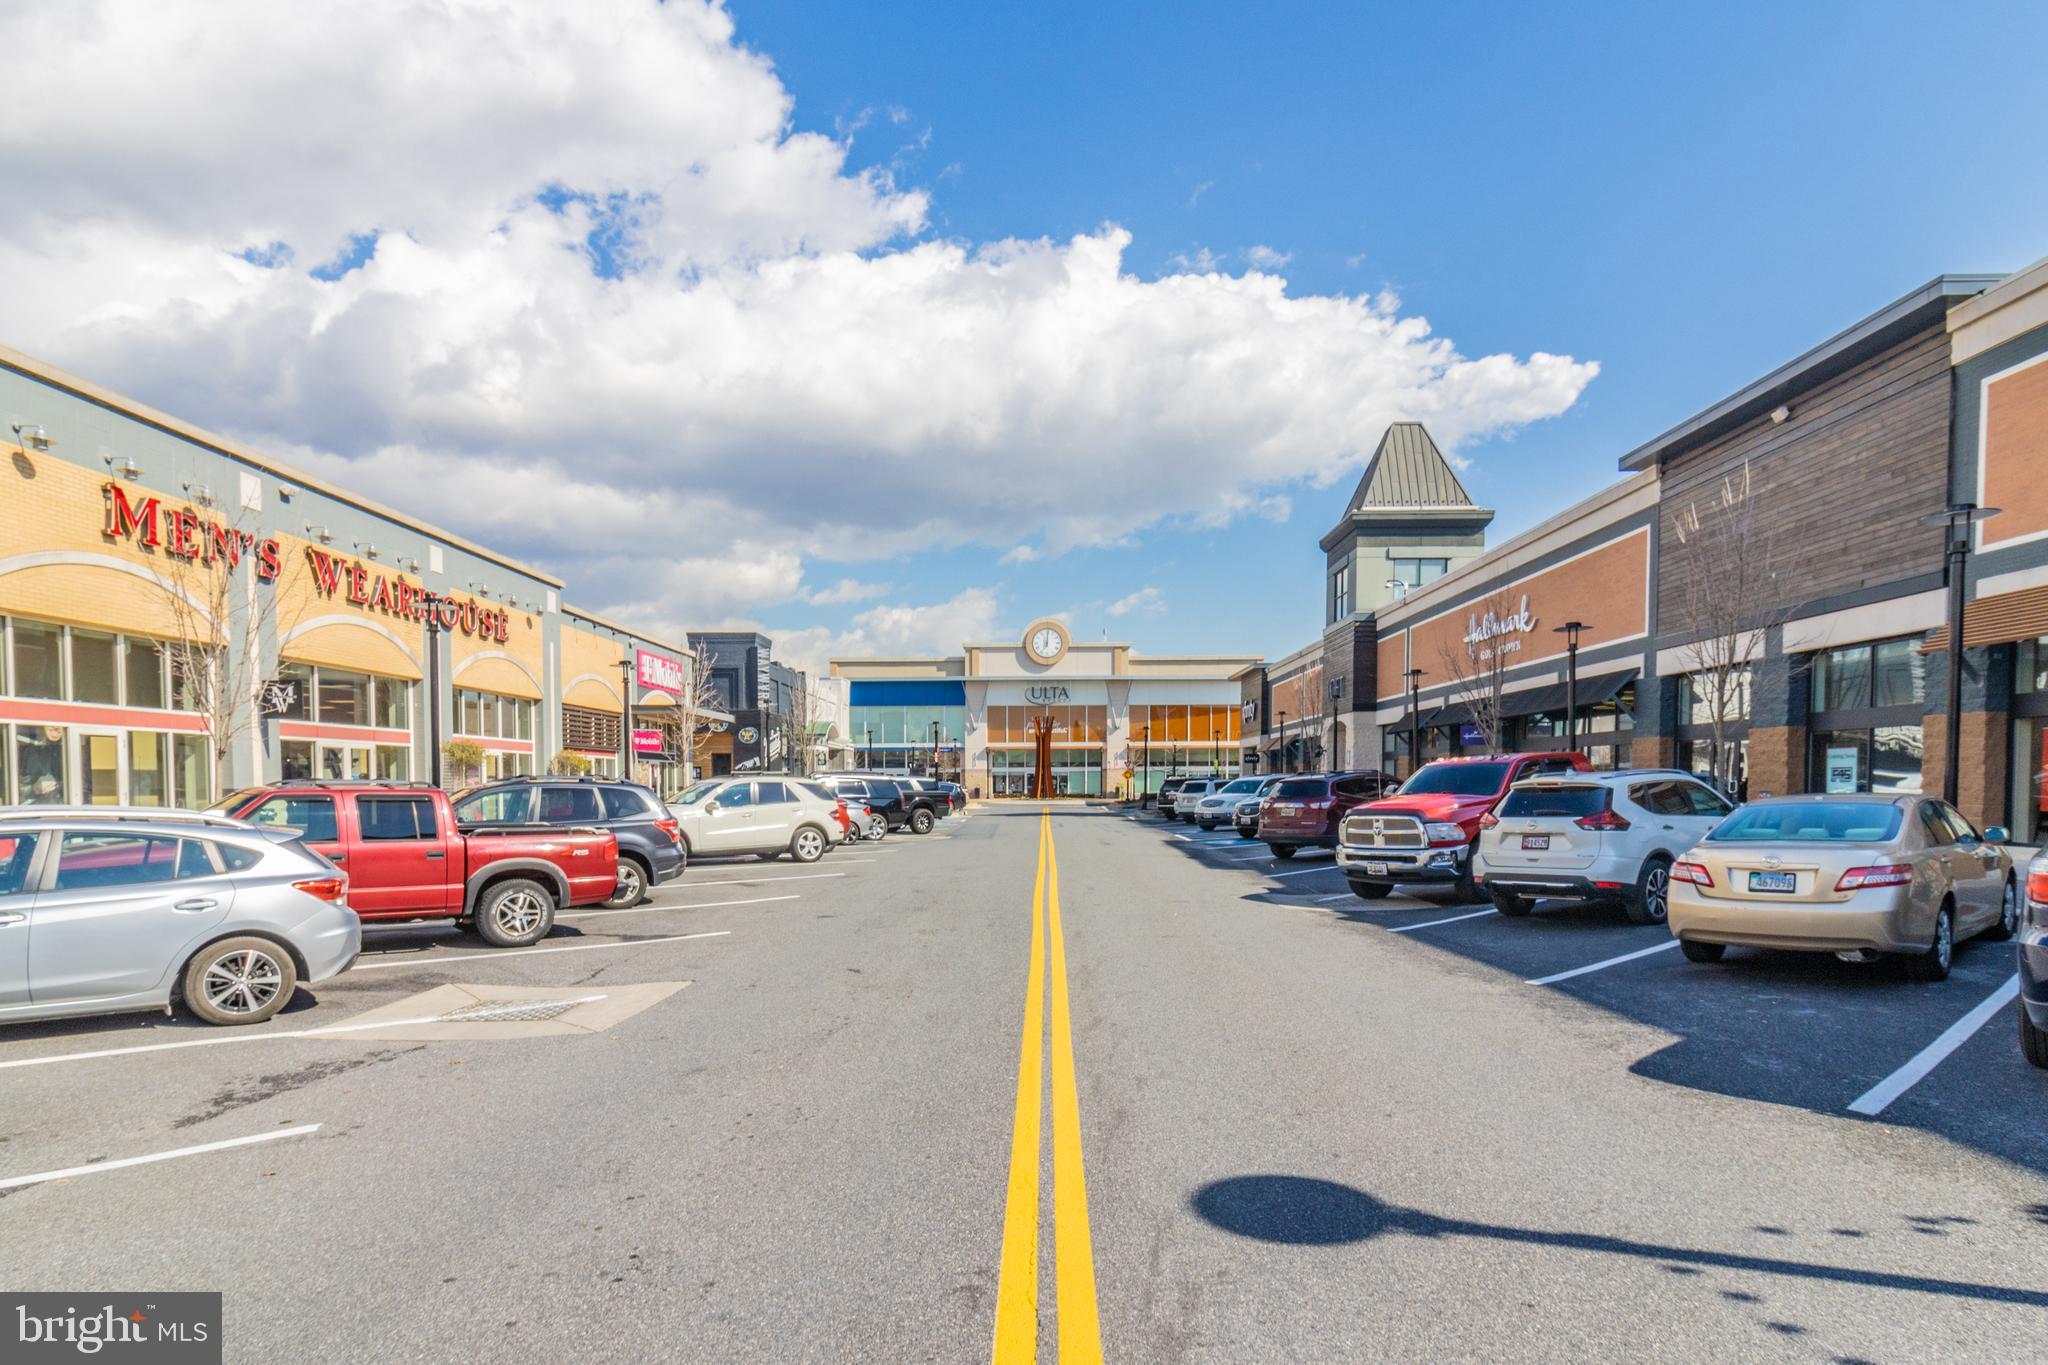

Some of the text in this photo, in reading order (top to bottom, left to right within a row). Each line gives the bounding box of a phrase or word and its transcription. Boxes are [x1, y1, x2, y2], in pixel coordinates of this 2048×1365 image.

[103, 483, 511, 642] MEN'S WEARHOUSE
[1462, 594, 1536, 659] Hallmark
[1031, 686, 1069, 699] ULTA
